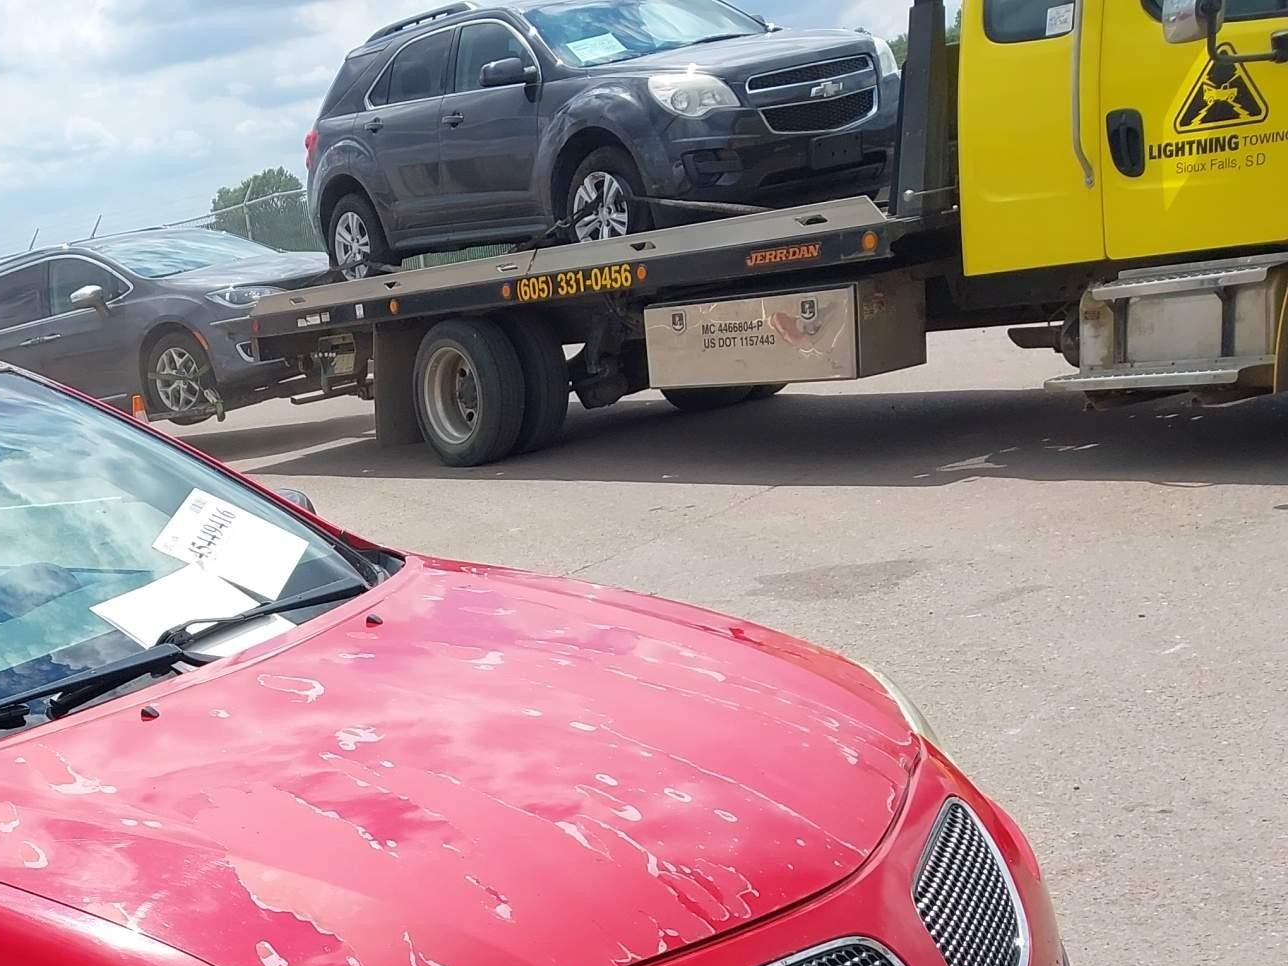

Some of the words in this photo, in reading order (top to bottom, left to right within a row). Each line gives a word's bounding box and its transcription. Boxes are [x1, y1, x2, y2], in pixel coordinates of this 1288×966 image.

[1149, 134, 1240, 160] LIGHTNING
[1176, 161, 1207, 174] Sioux
[1210, 158, 1241, 170] Falls,
[517, 276, 553, 302] (605)
[557, 264, 632, 295] 331-0456
[702, 324, 716, 334] MC
[704, 338, 716, 349] US
[718, 336, 738, 348] DOT
[740, 334, 775, 347] 1157443
[188, 506, 236, 559] 45449416
